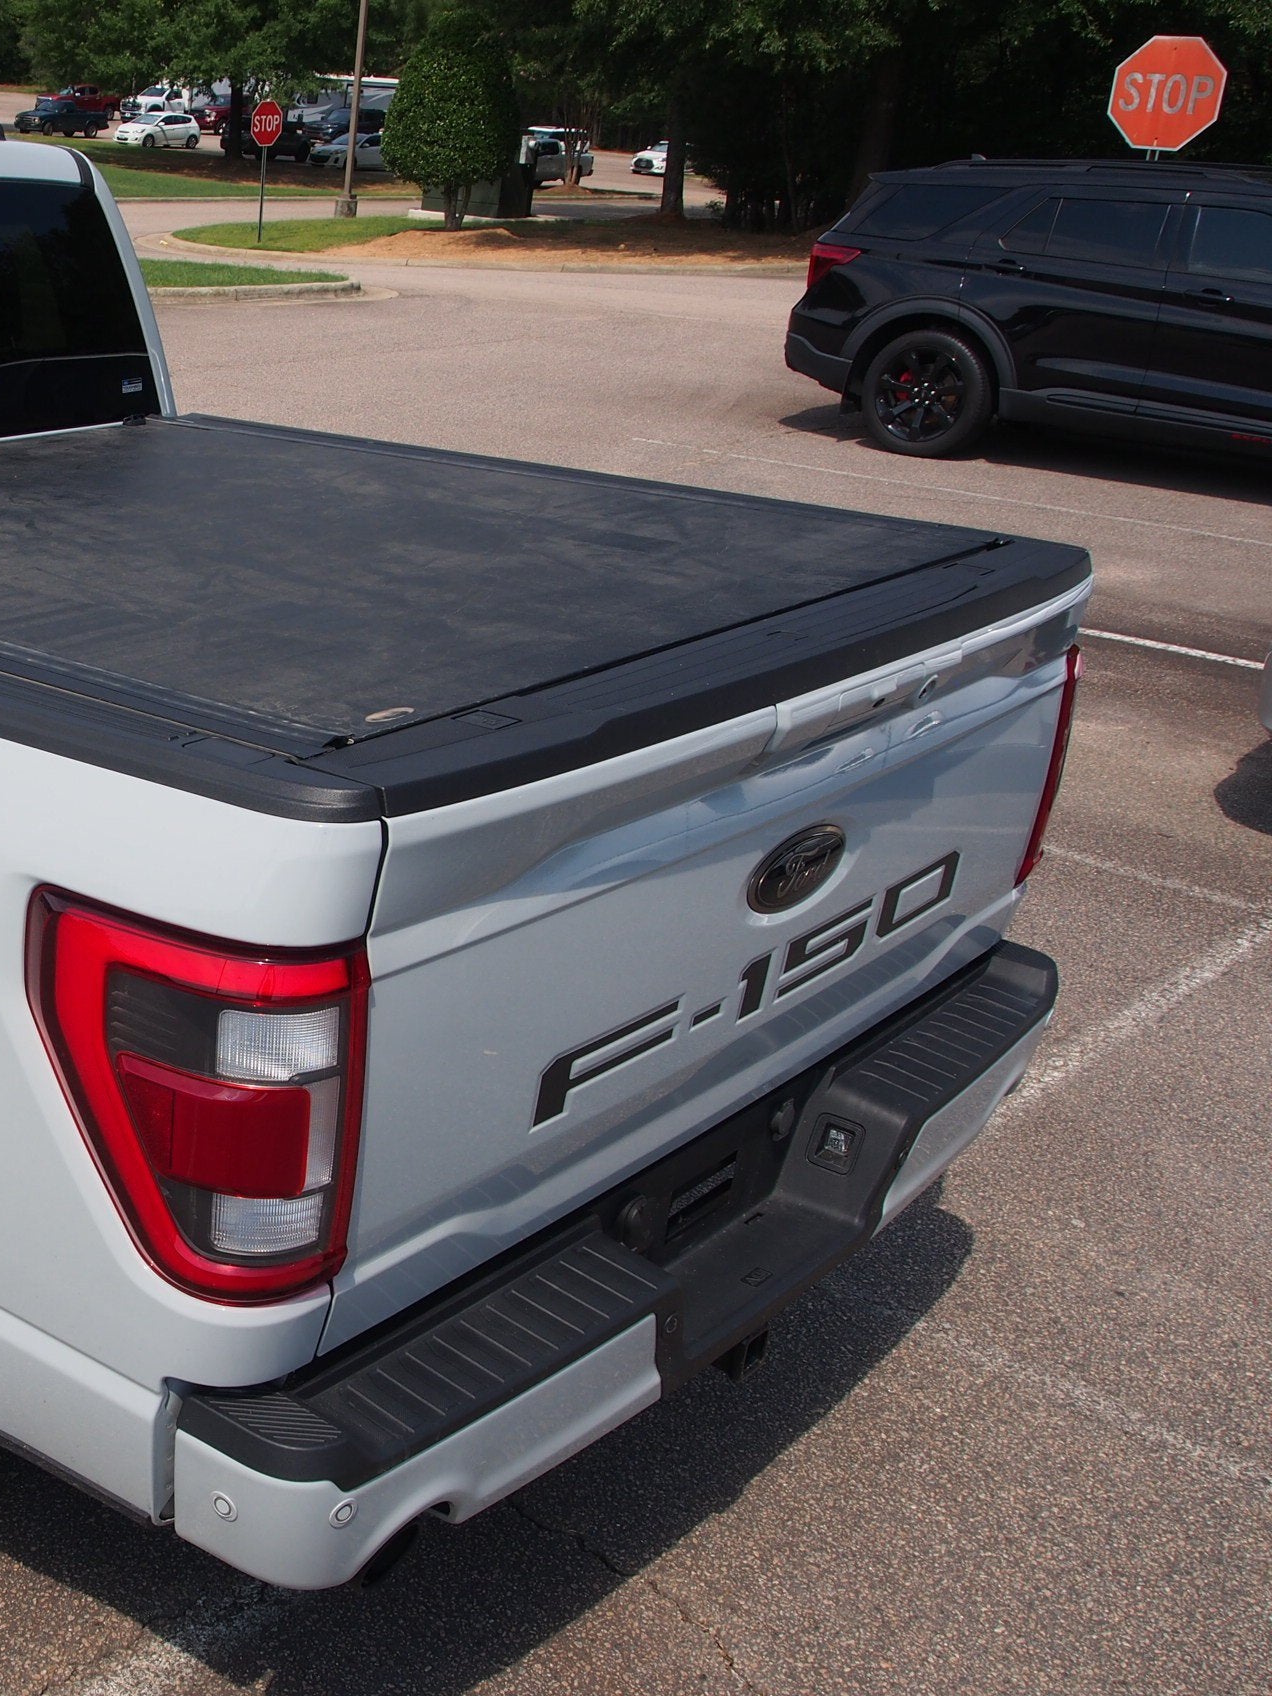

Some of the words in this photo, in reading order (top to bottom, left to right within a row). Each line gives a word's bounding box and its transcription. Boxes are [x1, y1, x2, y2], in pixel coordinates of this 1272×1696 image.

[1118, 72, 1215, 115] STOP
[253, 114, 280, 132] STOP
[776, 837, 839, 899] Ford
[531, 849, 961, 1129] F-150
